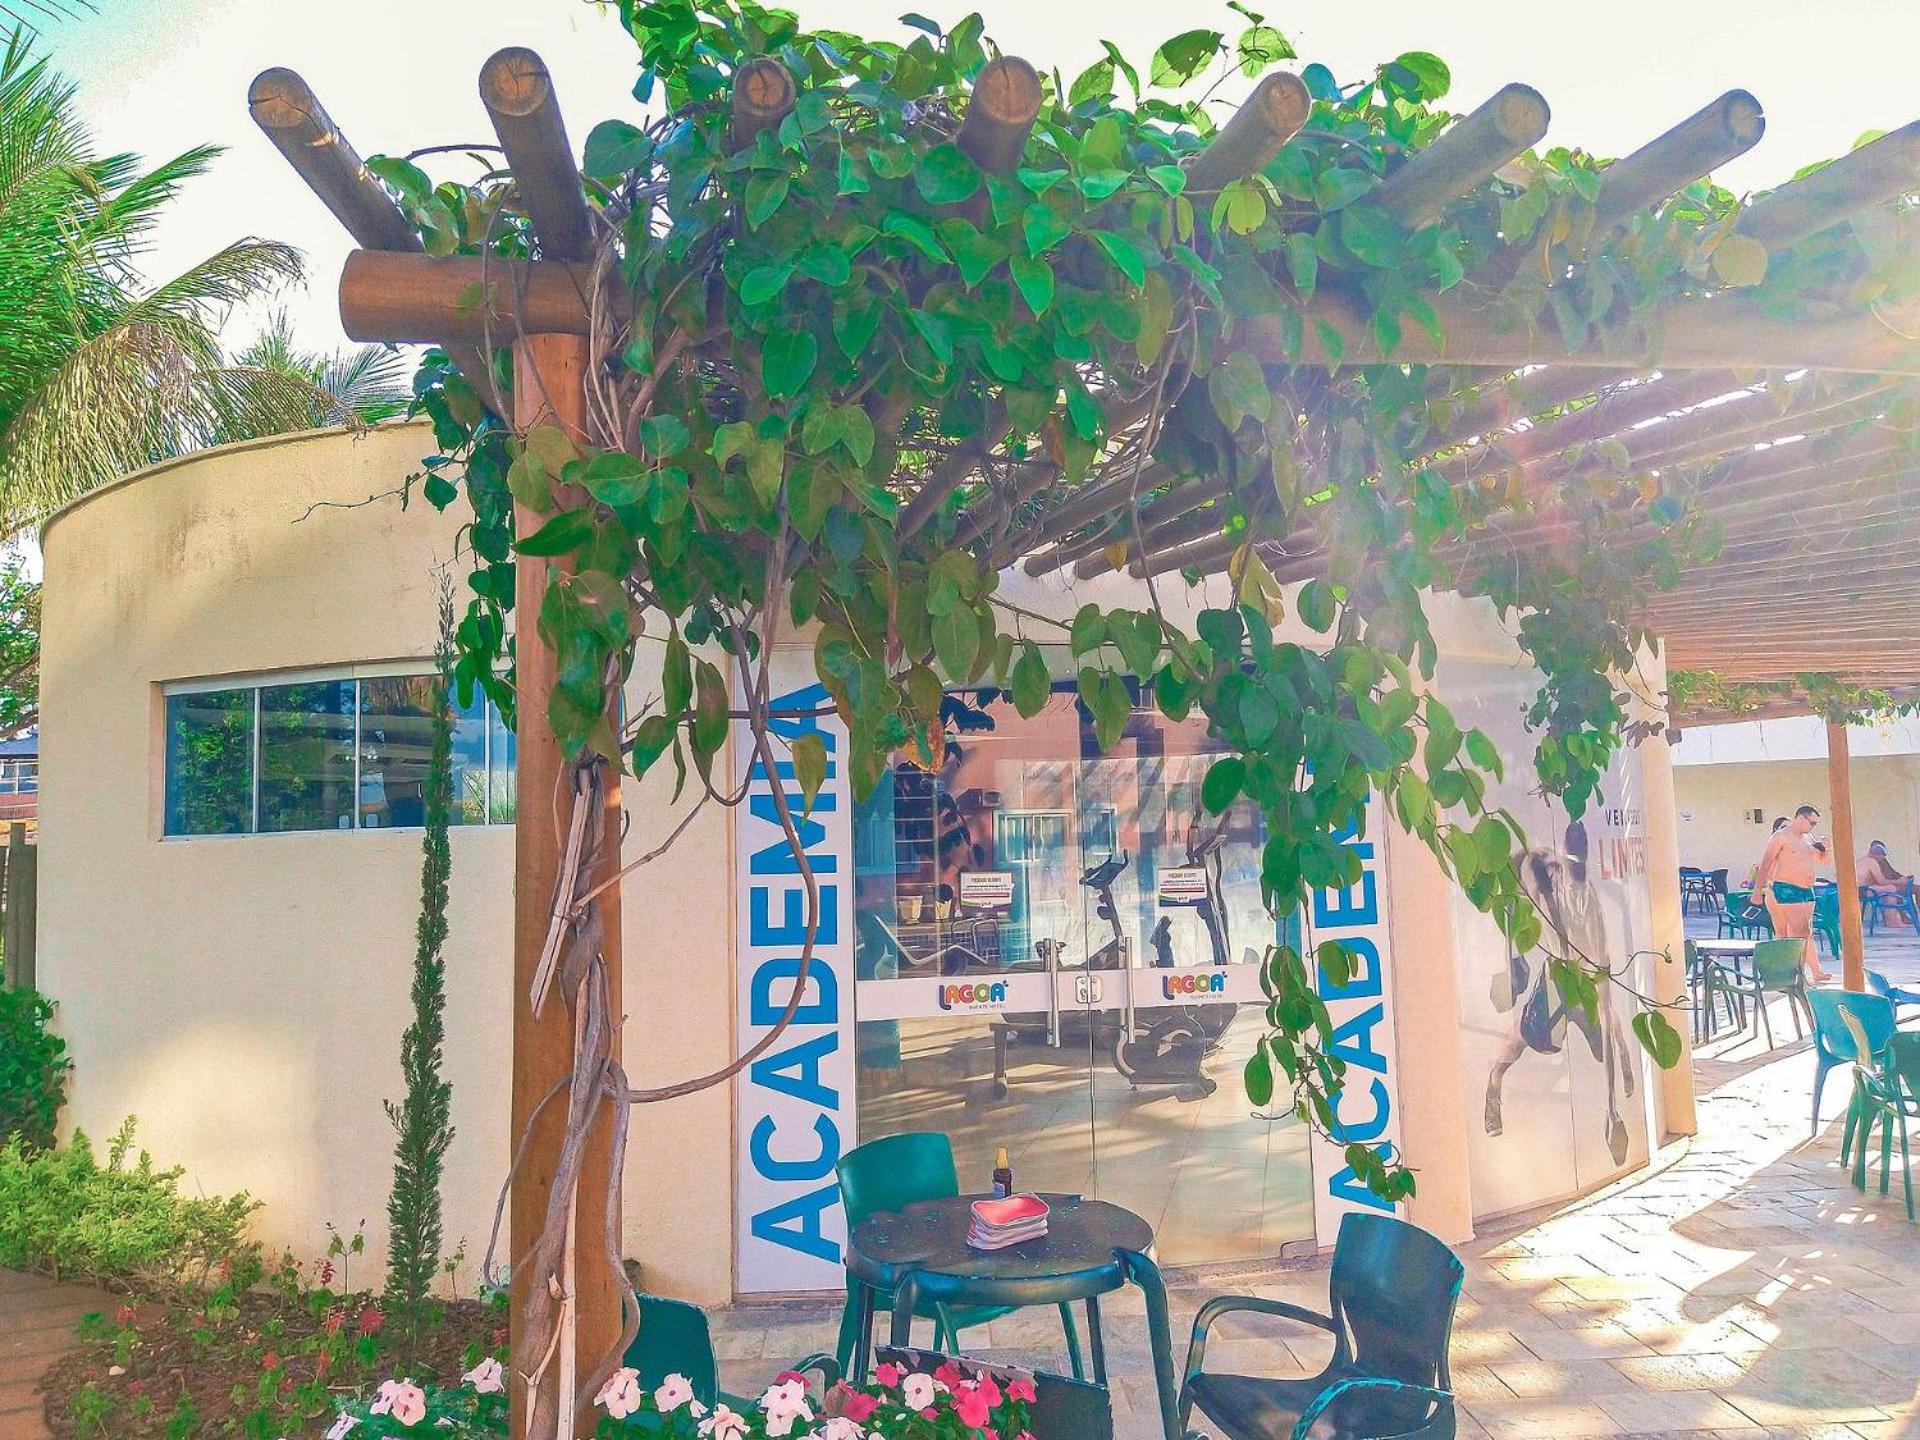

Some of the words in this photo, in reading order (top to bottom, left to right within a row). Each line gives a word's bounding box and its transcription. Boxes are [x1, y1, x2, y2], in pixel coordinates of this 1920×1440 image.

[750, 682, 841, 1264] ACADEMIA
[939, 982, 1006, 1011] LAGOA
[1162, 973, 1225, 1000] LAGOA
[1304, 757, 1397, 1214] ACADE
